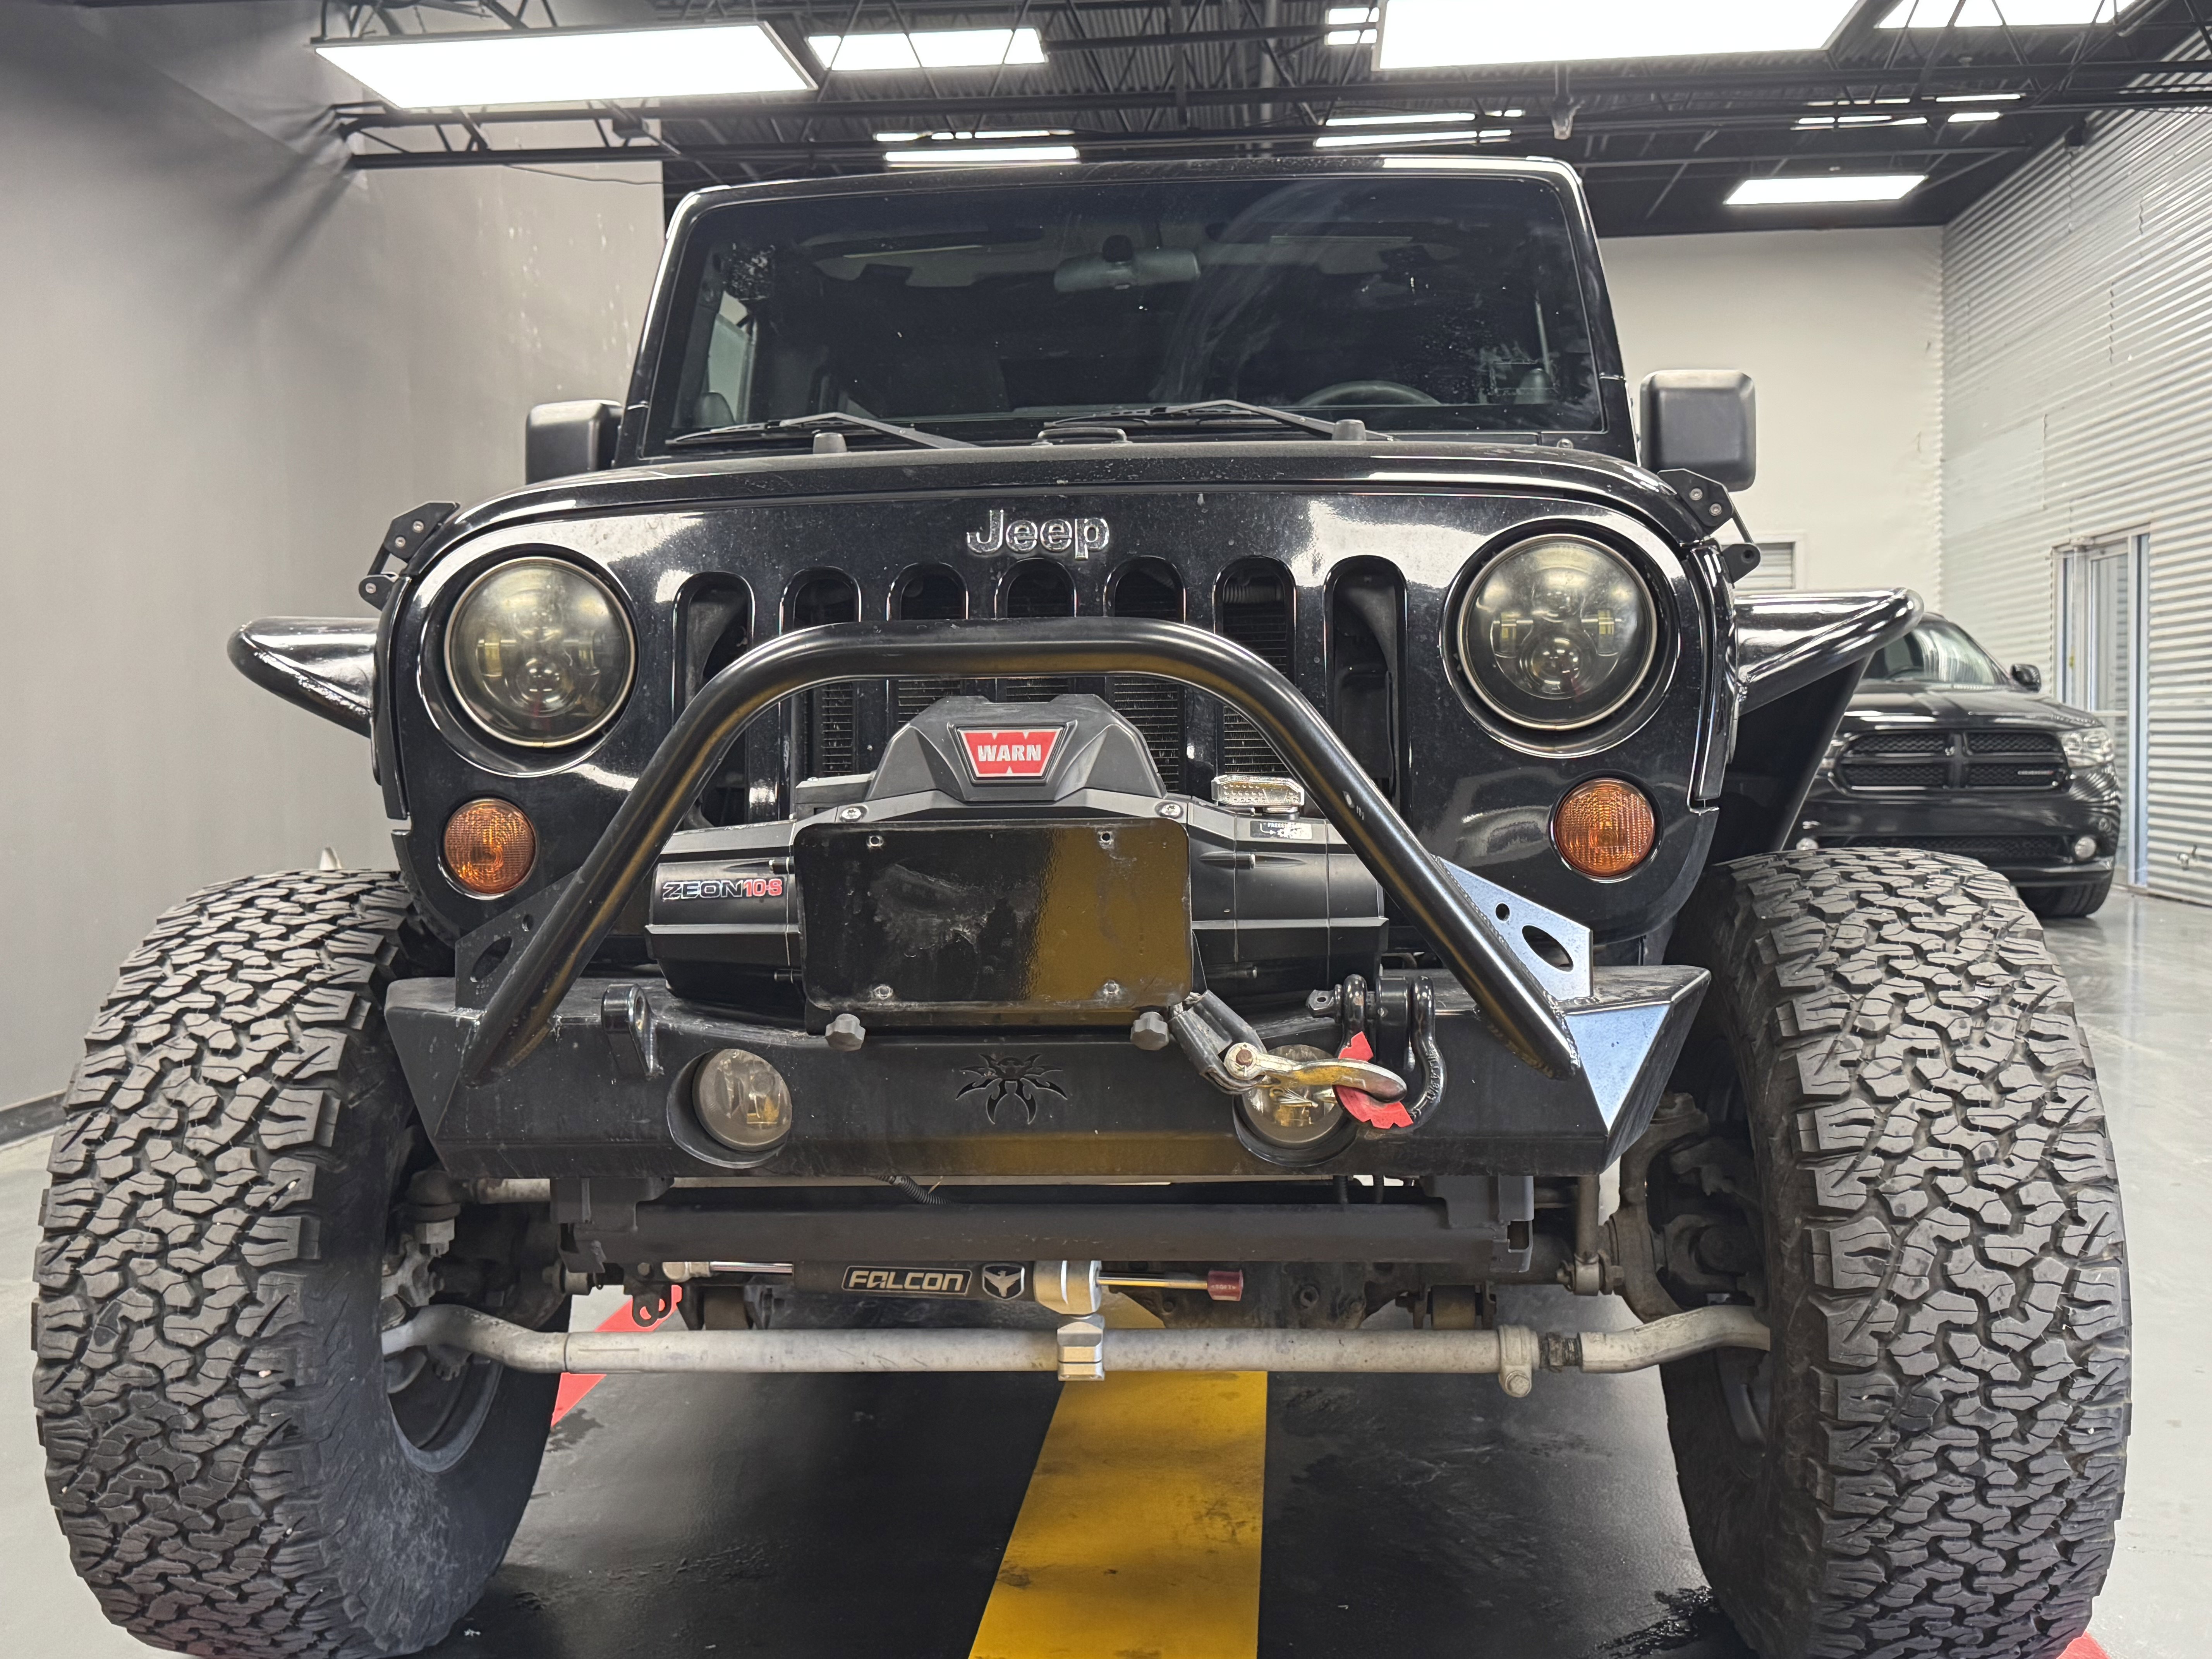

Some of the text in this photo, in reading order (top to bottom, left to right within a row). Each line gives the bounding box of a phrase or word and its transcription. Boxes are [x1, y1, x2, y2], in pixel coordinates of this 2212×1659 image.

[967, 509, 1109, 560] Jeep
[977, 744, 1041, 761] WARN
[848, 1270, 963, 1291] FALCON
